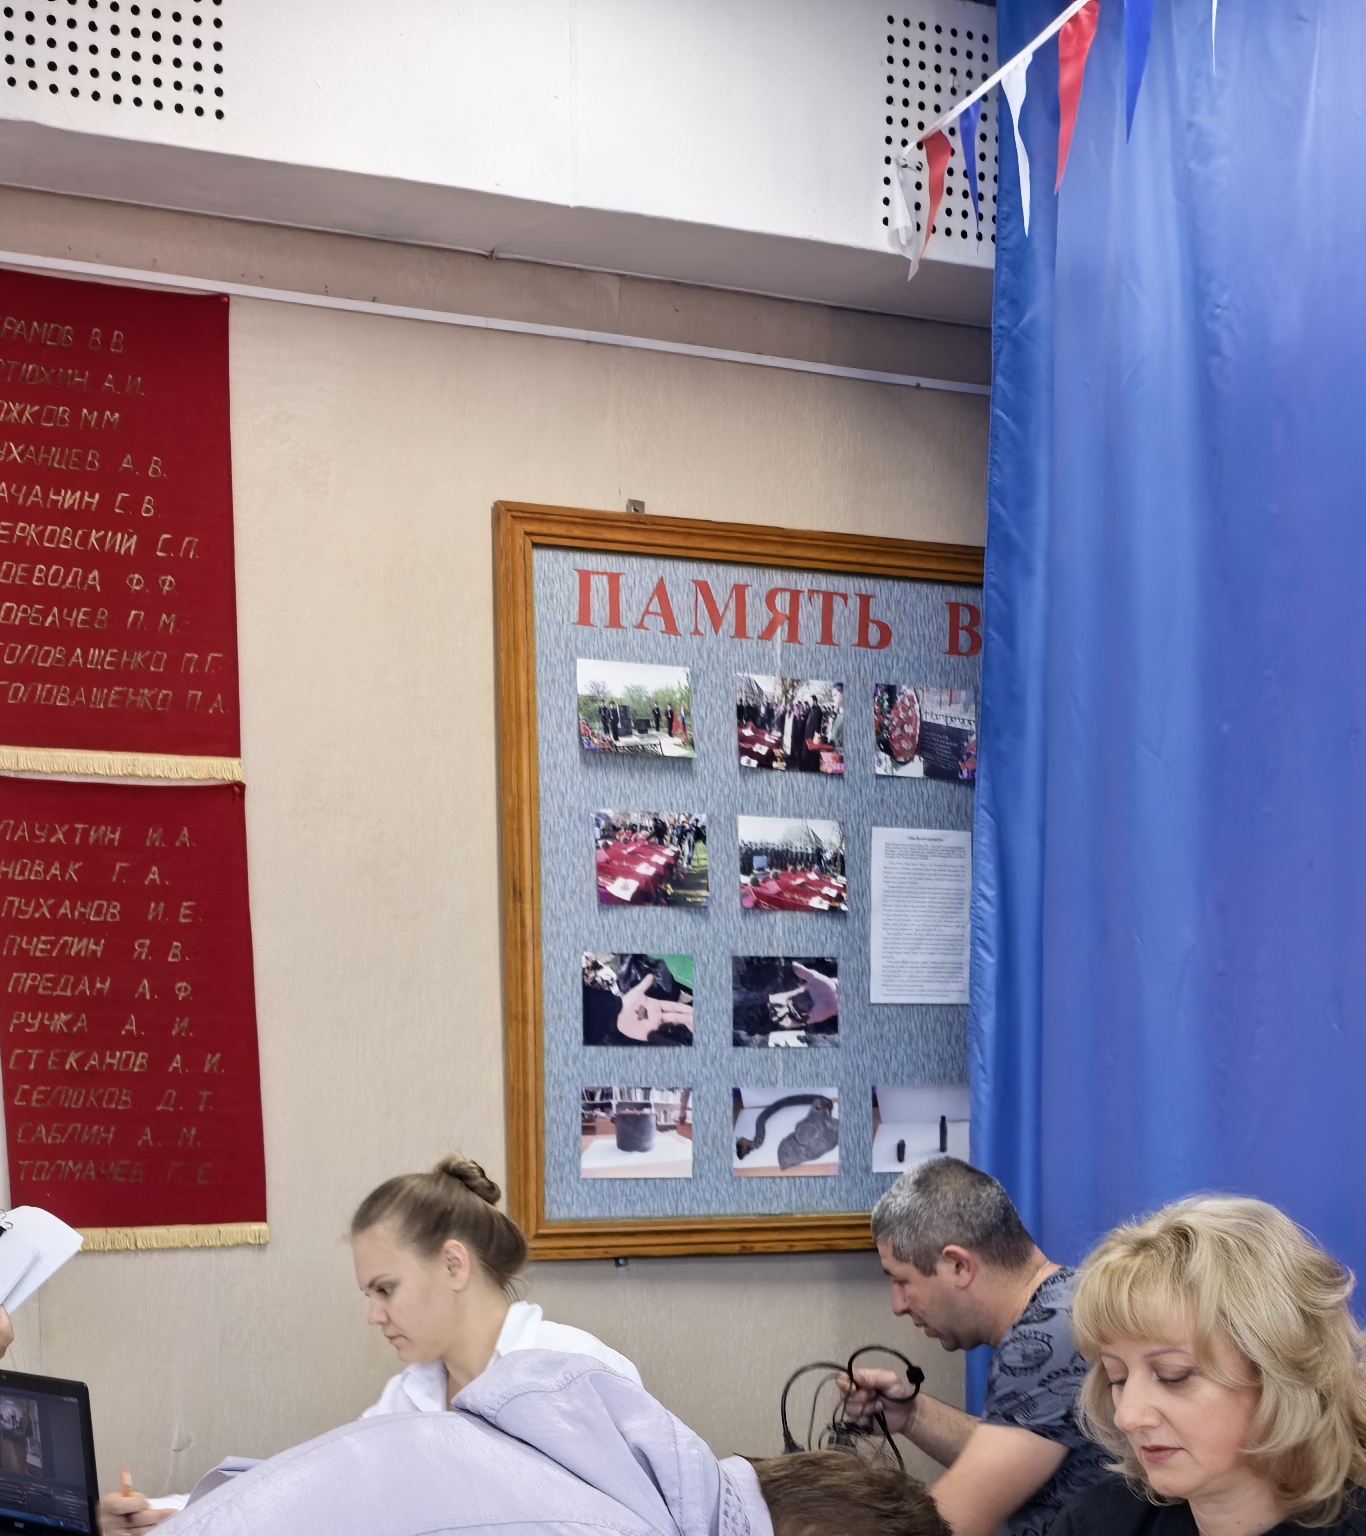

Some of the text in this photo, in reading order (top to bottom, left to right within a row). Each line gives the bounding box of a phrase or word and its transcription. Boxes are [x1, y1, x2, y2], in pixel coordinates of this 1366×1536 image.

[573, 568, 893, 651] ПАМЯТЬ
[2, 934, 105, 959] ПЧЕЛИН
[7, 971, 110, 998] ПРЕДАН
[9, 1011, 89, 1034] РУЧКА
[16, 1122, 116, 1147] САБЛИН
